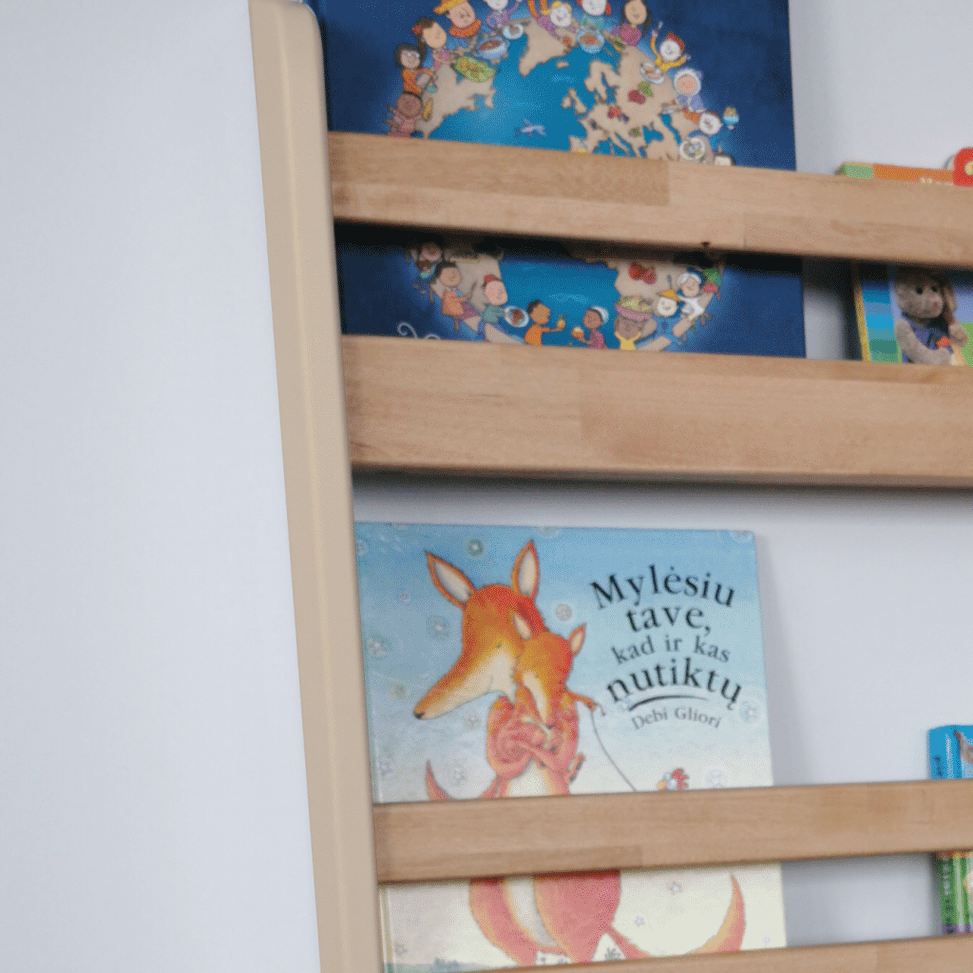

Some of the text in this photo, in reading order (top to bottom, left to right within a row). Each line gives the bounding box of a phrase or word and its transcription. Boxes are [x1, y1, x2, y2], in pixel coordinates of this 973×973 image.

[590, 563, 735, 610] Mylėsiu
[626, 606, 711, 636] tave,
[611, 634, 731, 665] kad ir kas
[607, 657, 742, 711] nutiktų
[631, 707, 722, 731] Debi Gliori
